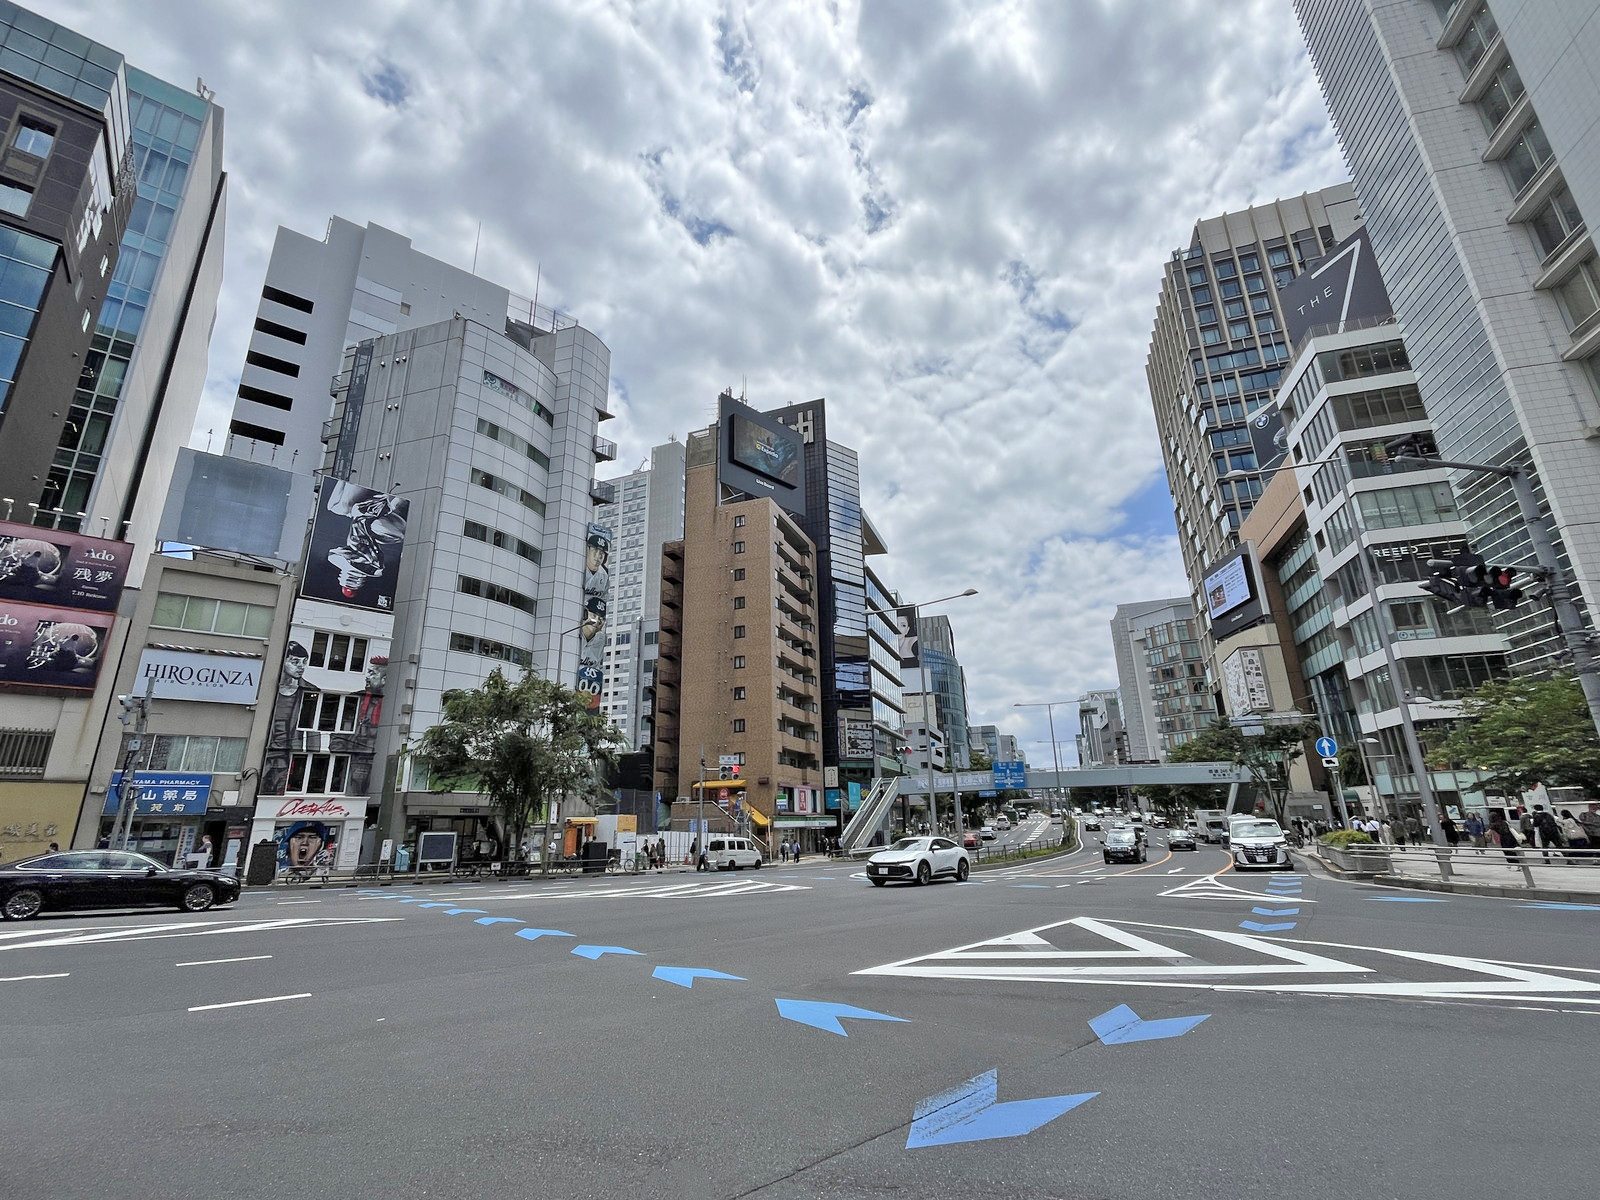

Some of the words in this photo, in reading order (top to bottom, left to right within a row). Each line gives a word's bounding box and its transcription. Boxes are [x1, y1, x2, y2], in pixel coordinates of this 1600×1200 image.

[1310, 238, 1361, 334] 7
[1297, 285, 1333, 316] THE
[84, 548, 115, 562] Ado
[72, 567, 114, 583] 残夢
[0, 614, 18, 626] do
[143, 663, 194, 685] HIRO
[196, 667, 254, 687] GINZA
